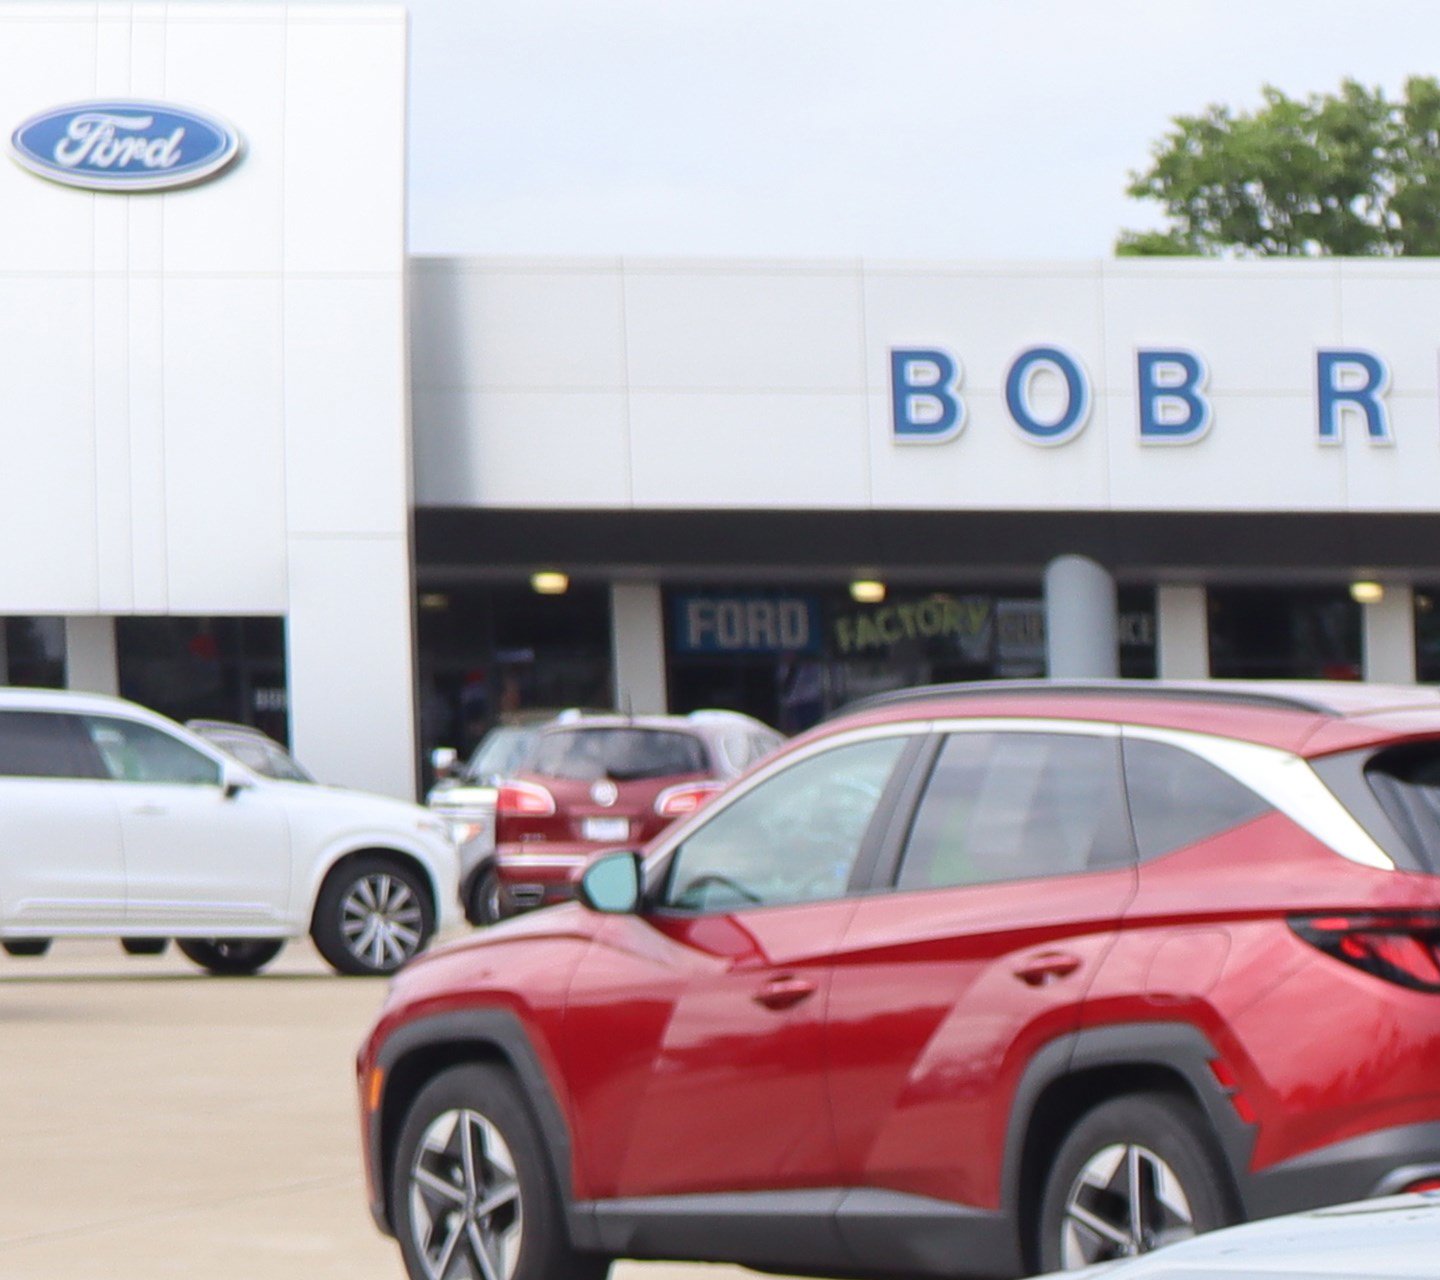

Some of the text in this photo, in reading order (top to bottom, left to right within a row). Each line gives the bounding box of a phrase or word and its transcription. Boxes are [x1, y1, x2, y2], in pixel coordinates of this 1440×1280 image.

[889, 346, 1211, 443] BOB
[685, 600, 811, 649] FORD
[834, 598, 990, 652] FACTORY
